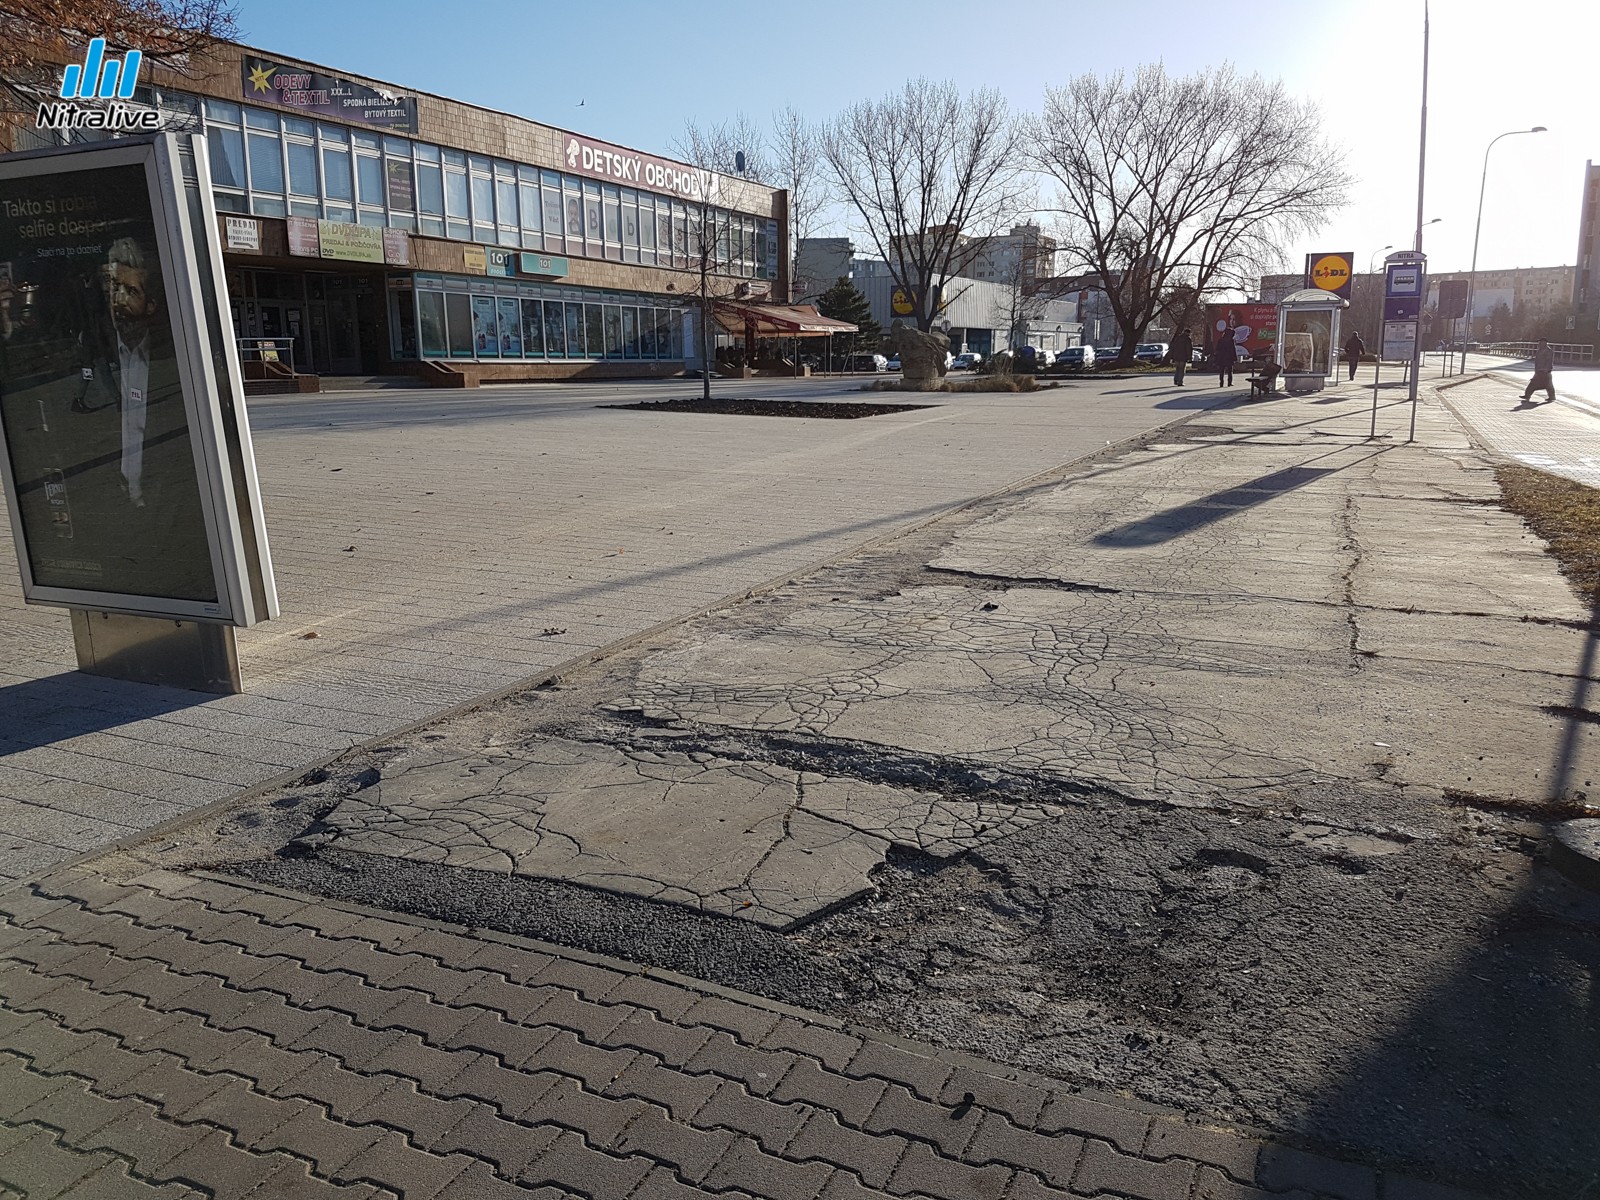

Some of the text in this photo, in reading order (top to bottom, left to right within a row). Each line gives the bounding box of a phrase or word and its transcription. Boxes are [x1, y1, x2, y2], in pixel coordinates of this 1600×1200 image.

[274, 74, 312, 90] ODEVY
[282, 89, 331, 106] &TEXTIL
[343, 96, 393, 107] SPODNÁ BIELIZ
[364, 108, 406, 119] BYTOVÝ TEXTIL
[582, 145, 699, 196] DETSKÝ OBCHOD
[2, 198, 42, 218] Takto
[45, 196, 56, 214] si
[18, 218, 55, 239] selfie
[227, 218, 256, 230] PREDAJ
[322, 238, 344, 246] PREDAJ
[322, 247, 335, 255] DVD
[491, 252, 508, 265] 101
[540, 259, 551, 268] 101
